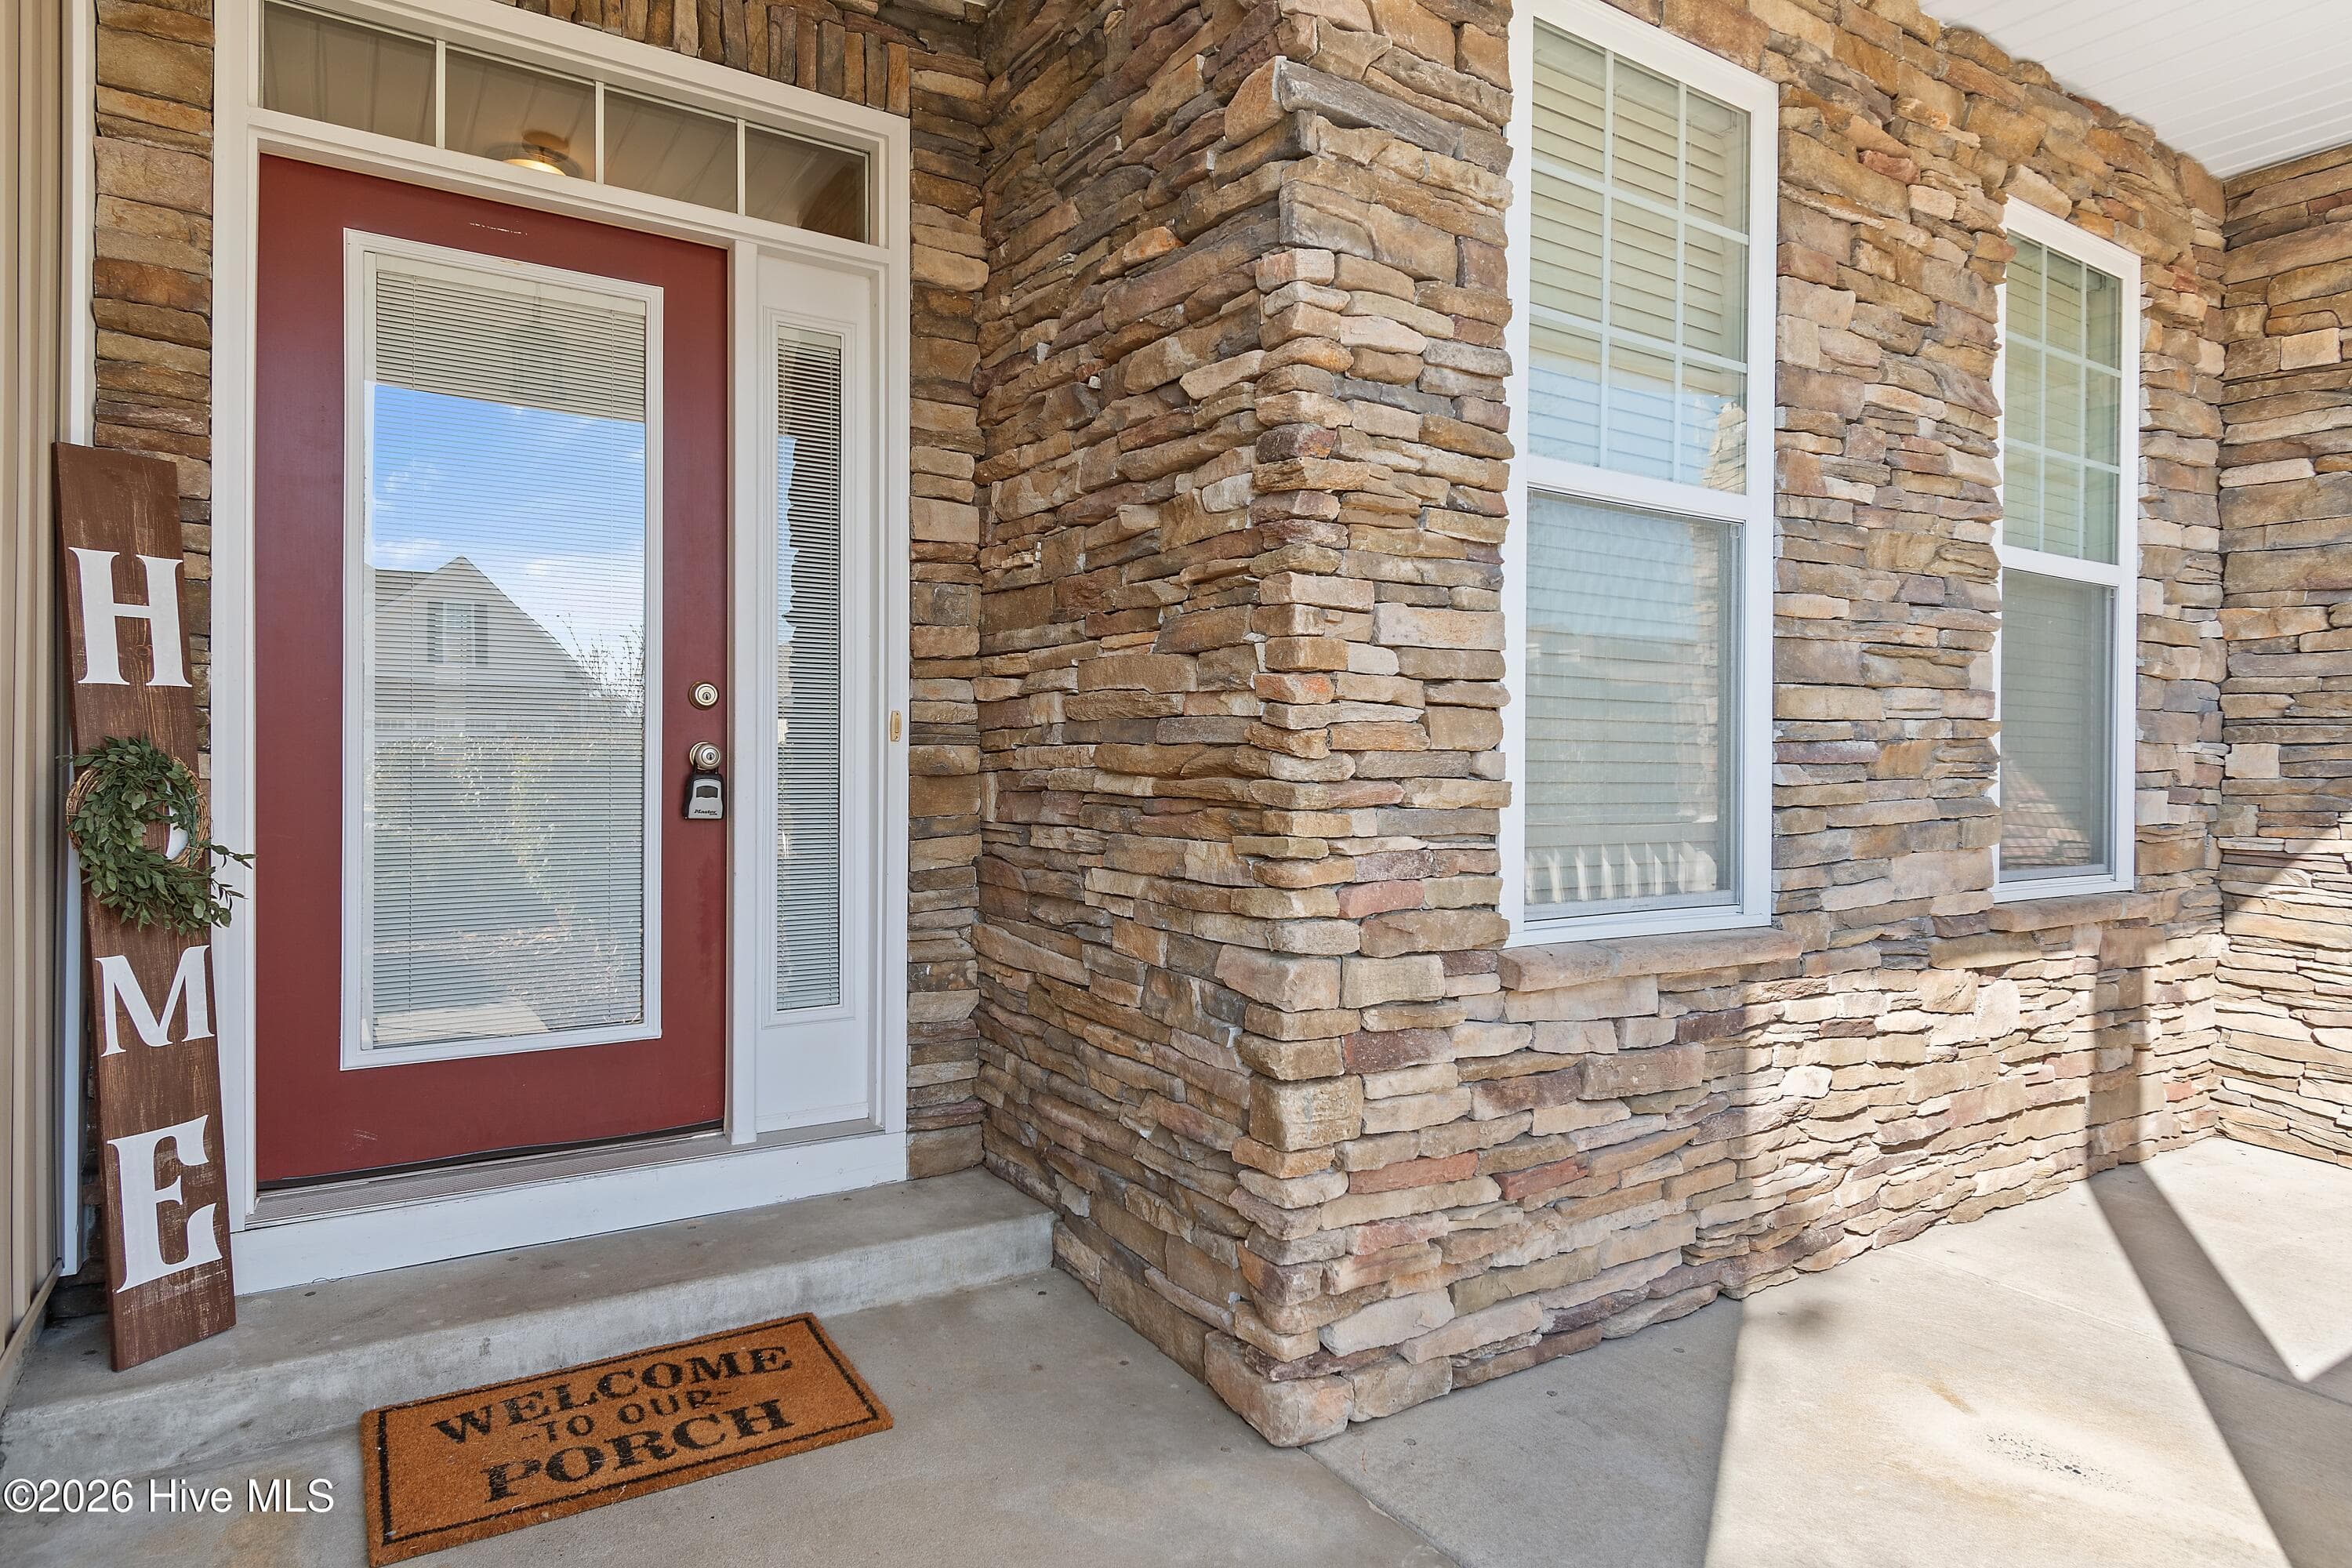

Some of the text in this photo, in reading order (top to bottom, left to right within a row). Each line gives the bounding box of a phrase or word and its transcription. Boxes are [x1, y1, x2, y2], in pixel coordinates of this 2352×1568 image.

[68, 546, 223, 1294] HME
[431, 1346, 793, 1444] WELCOME
[481, 1399, 795, 1503] PORCH
